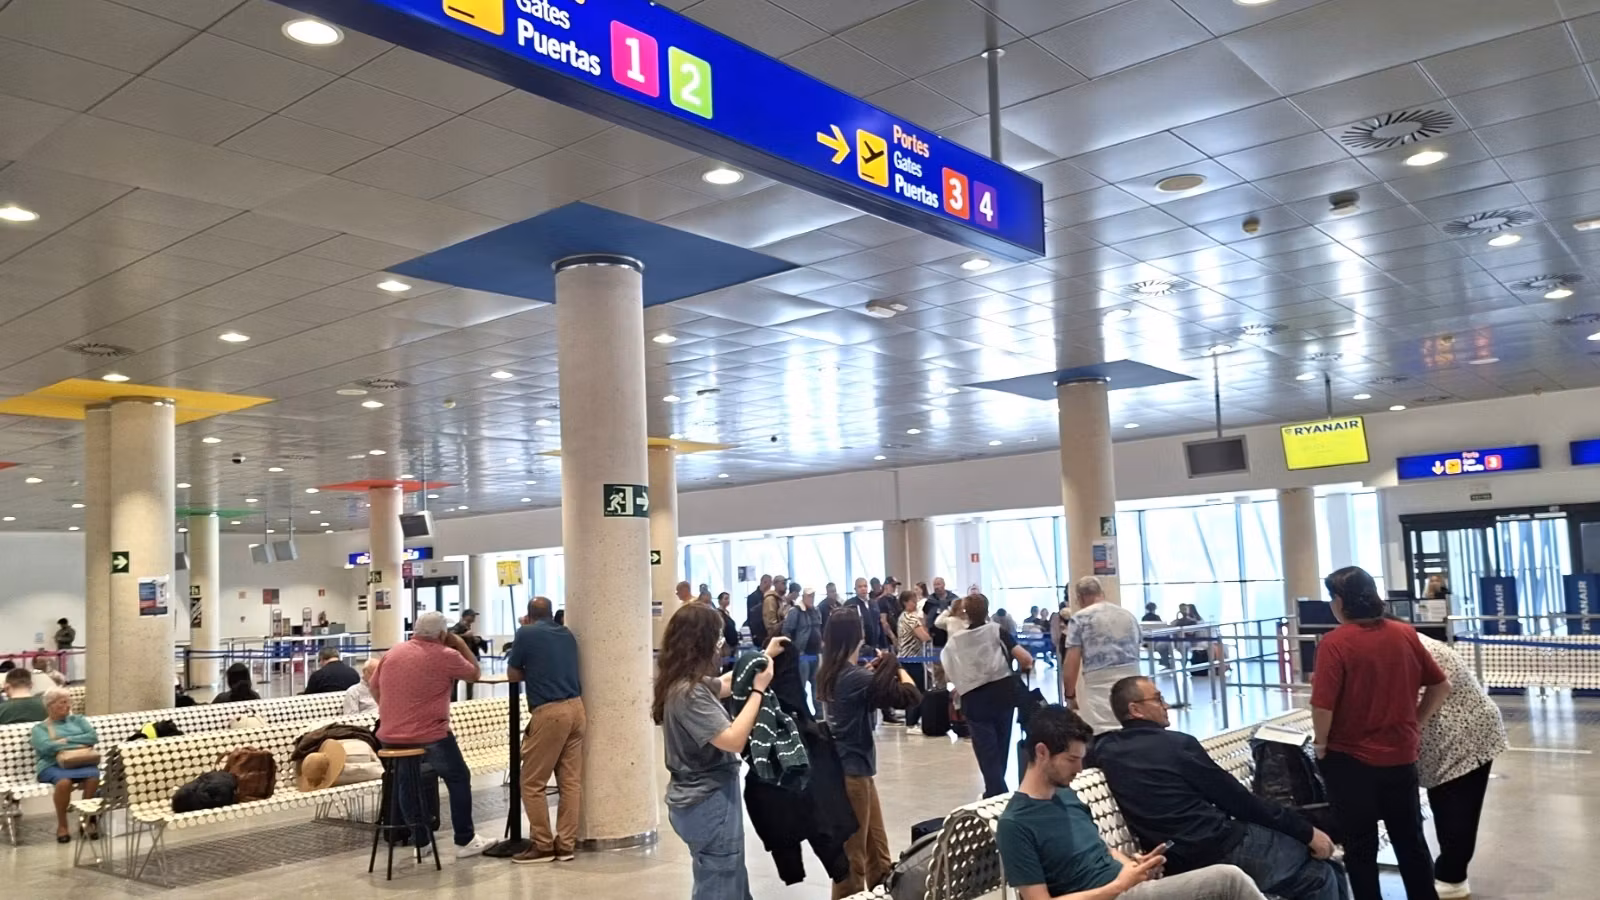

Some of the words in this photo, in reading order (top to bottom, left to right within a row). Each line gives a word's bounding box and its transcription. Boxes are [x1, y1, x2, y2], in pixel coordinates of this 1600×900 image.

[517, 17, 601, 76] Puertas
[625, 37, 645, 83] 1
[680, 61, 703, 106] 2
[893, 124, 930, 158] Portes
[893, 150, 923, 178] Gates
[894, 173, 940, 209] Puertas
[949, 177, 964, 211] 3
[979, 191, 994, 222] 4
[1294, 420, 1359, 436] RYANAIR
